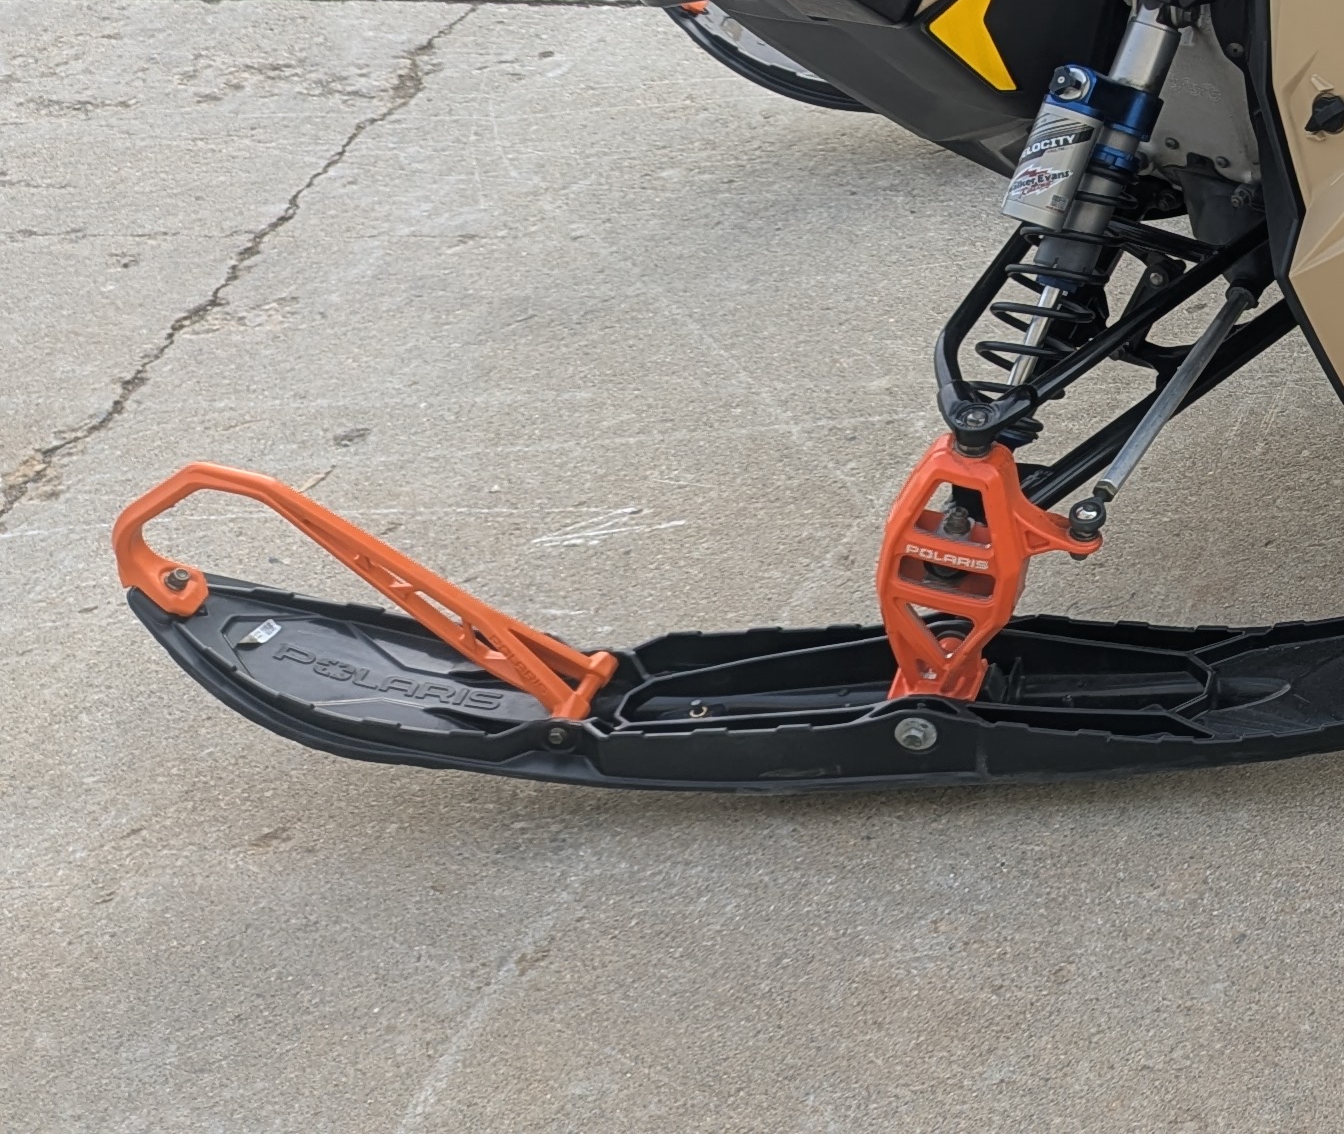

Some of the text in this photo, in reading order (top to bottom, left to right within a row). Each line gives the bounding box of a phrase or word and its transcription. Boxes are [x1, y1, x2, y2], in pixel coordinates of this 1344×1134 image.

[1021, 134, 1075, 158] ELOCITY
[1037, 170, 1070, 183] Evans
[906, 544, 989, 570] POLARIS
[272, 641, 506, 712] POLARIS
